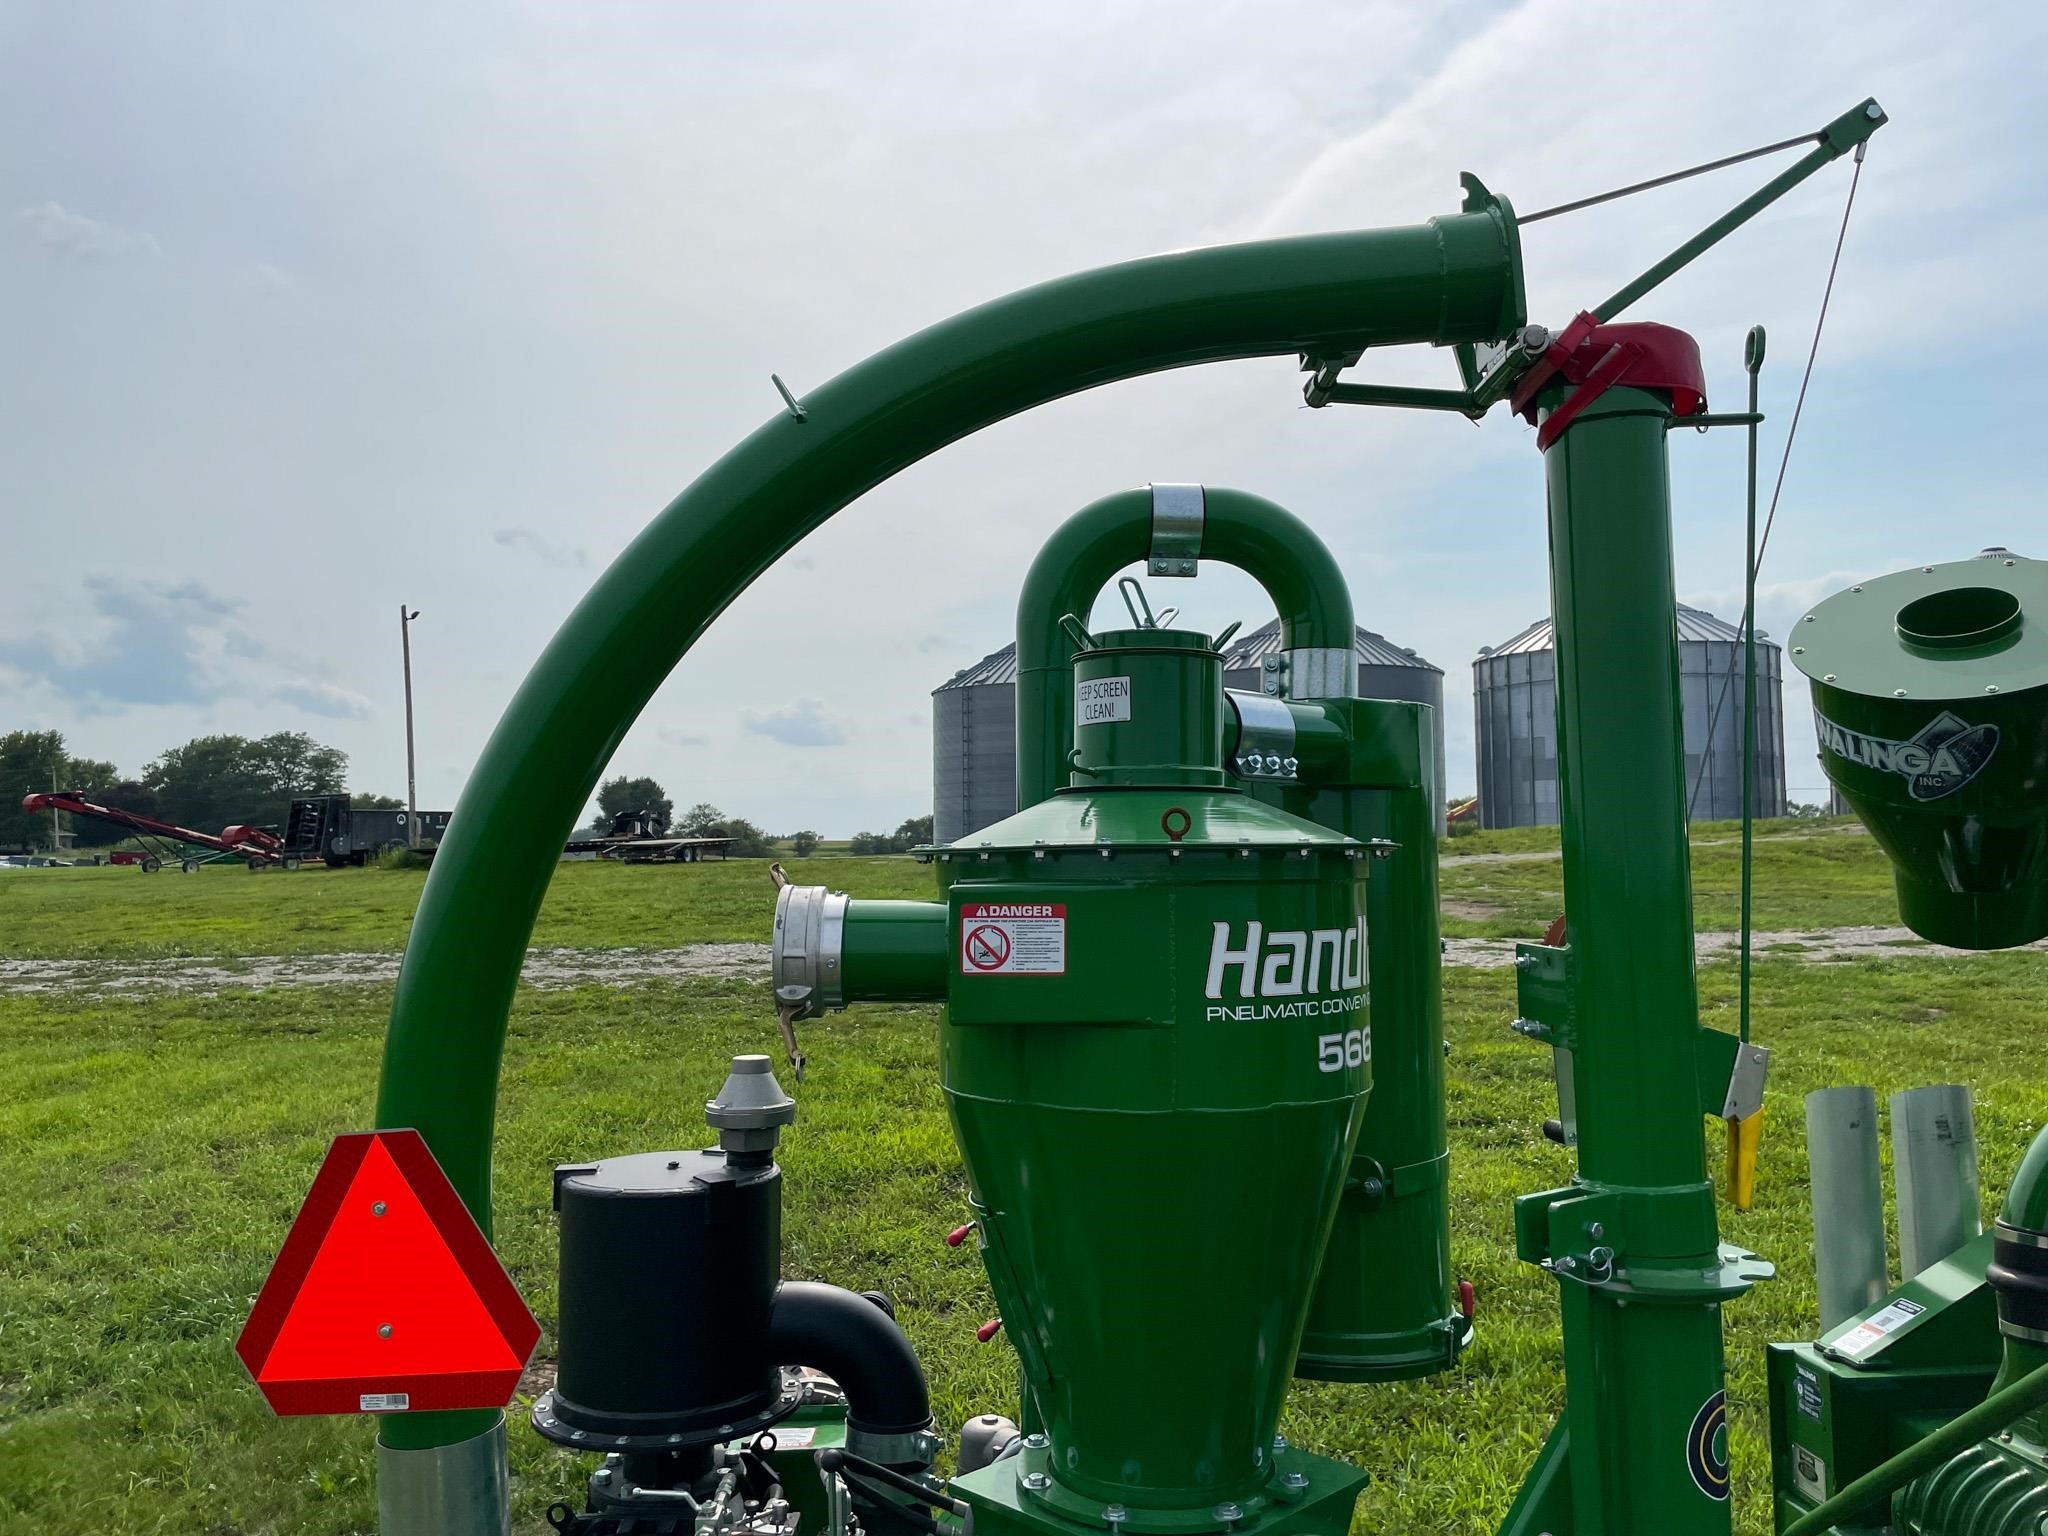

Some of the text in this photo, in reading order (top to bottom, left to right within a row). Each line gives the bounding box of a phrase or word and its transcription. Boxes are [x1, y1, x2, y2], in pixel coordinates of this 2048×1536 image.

[1079, 681, 1128, 701] EEP SCREEN
[1085, 702, 1115, 720] CLEAN!
[1814, 709, 1963, 776] WALINGA
[1919, 777, 1946, 787] INC.
[989, 906, 1053, 917] DANGER
[1205, 915, 1370, 999] Handl
[1207, 1001, 1319, 1021] PNEUMATIC
